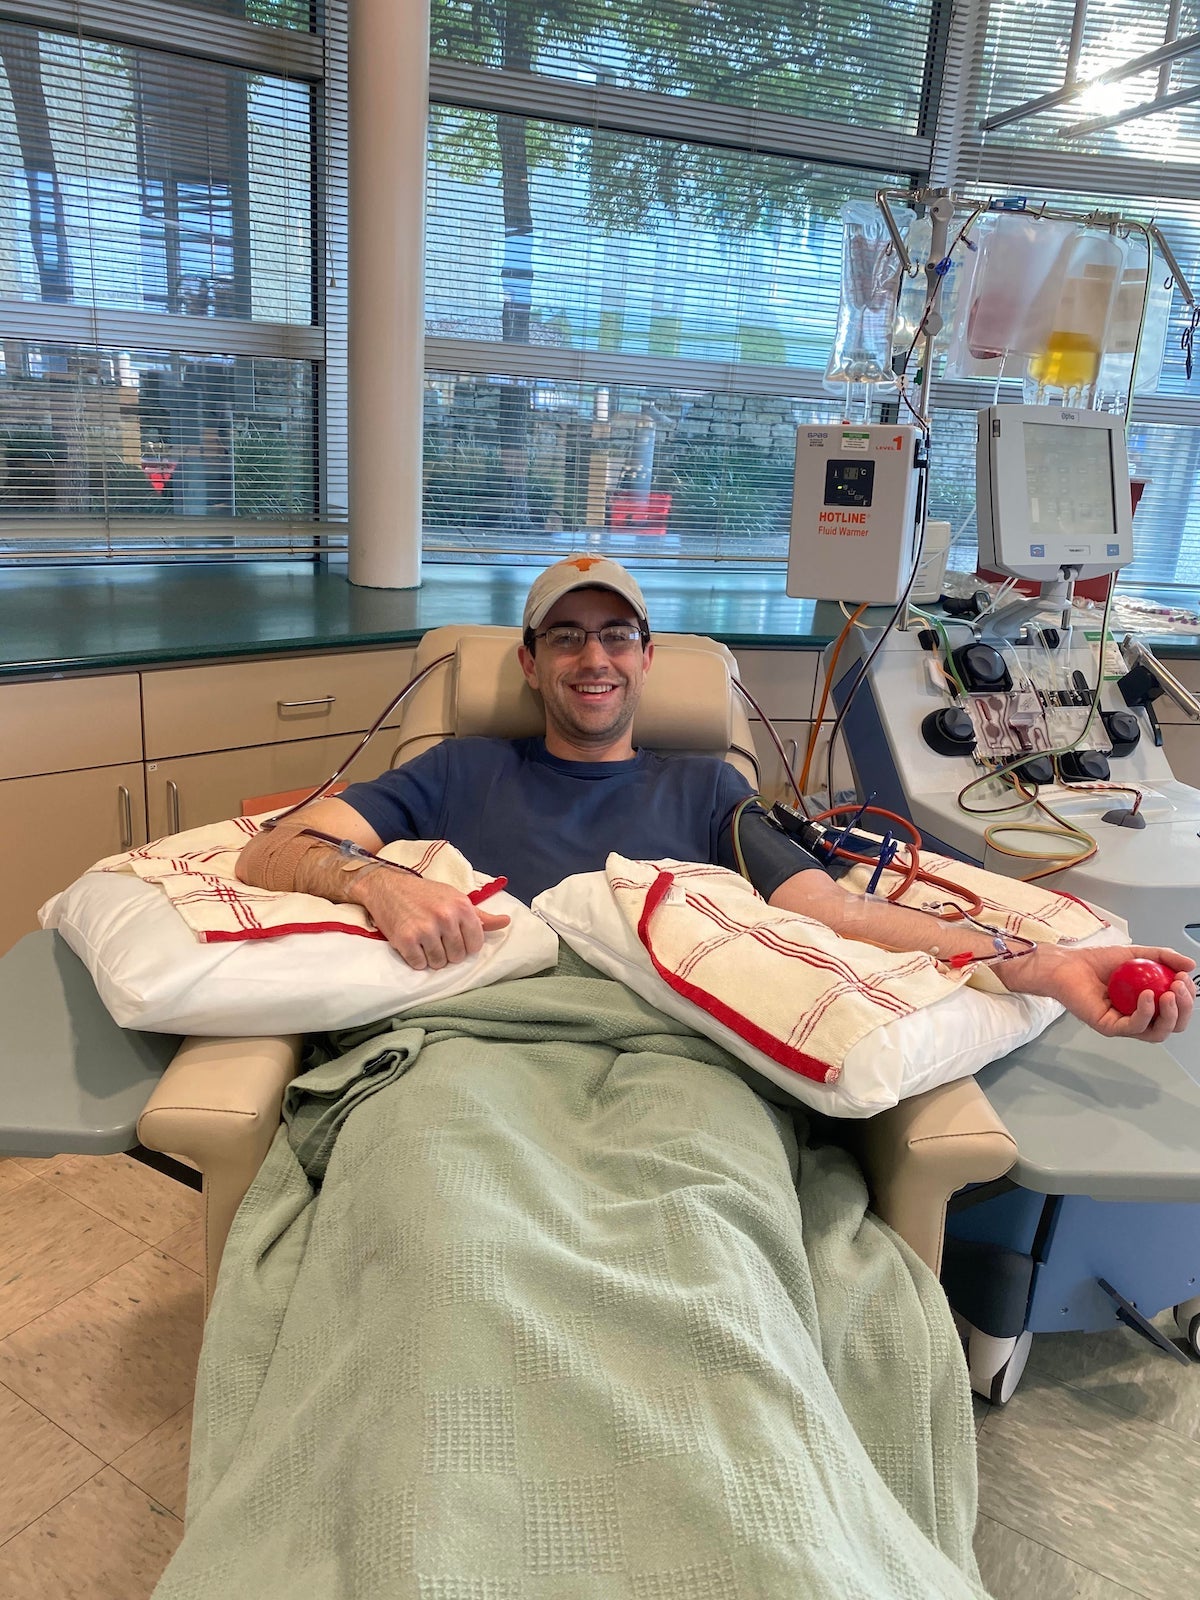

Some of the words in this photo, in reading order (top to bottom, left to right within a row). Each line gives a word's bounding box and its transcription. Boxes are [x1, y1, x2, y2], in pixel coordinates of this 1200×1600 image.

[893, 436, 902, 451] 1
[819, 512, 866, 524] HOTLINE
[818, 525, 837, 536] Fluid
[839, 526, 869, 537] Warmer
